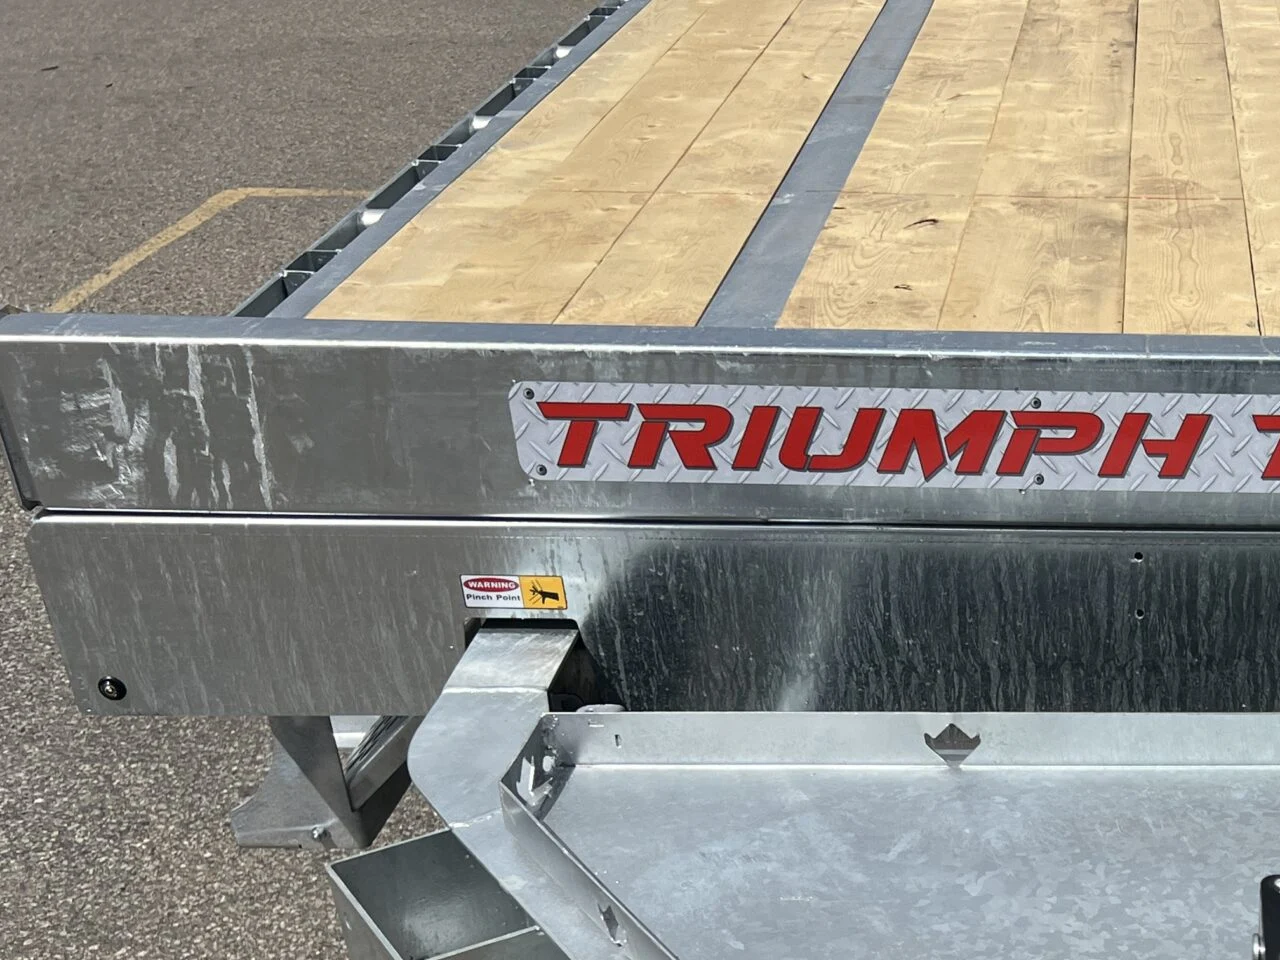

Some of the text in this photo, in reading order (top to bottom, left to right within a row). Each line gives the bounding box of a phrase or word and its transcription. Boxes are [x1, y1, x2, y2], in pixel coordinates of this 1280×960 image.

[537, 402, 1213, 482] TRIUMPH
[468, 581, 516, 589] WARNING
[466, 593, 521, 601] Pinch Point
